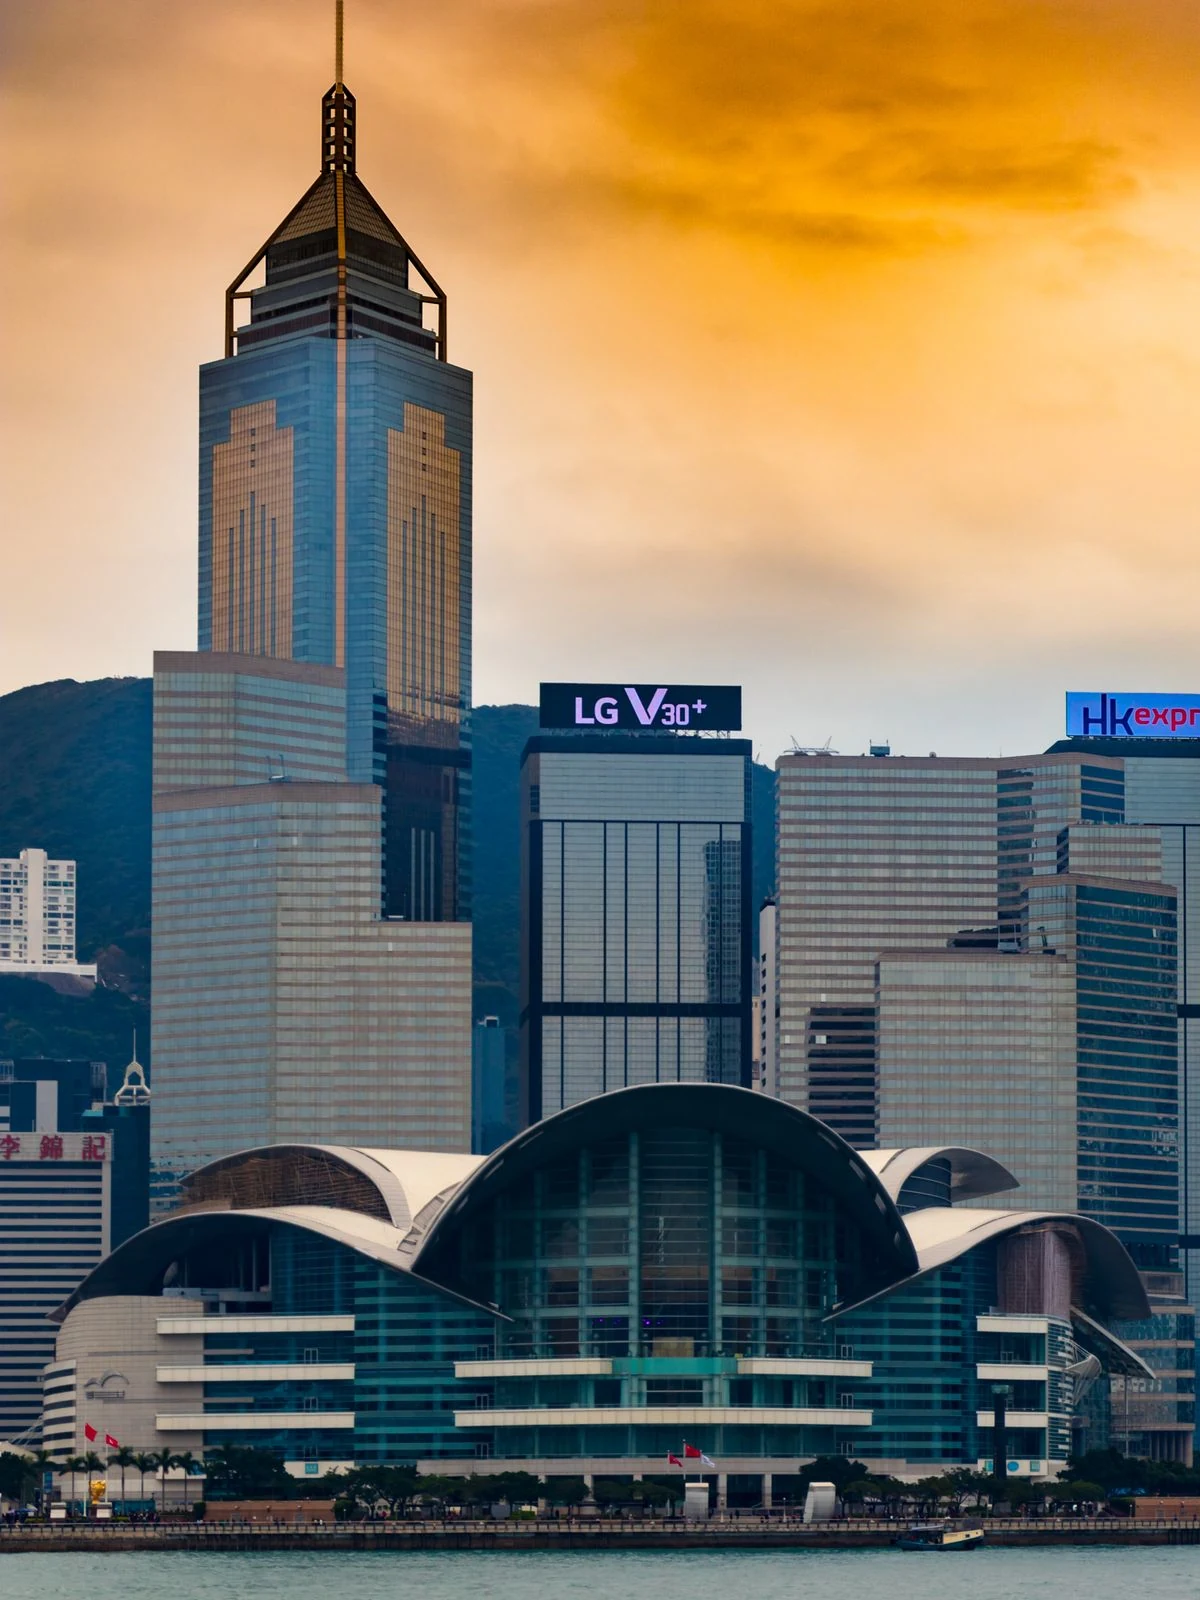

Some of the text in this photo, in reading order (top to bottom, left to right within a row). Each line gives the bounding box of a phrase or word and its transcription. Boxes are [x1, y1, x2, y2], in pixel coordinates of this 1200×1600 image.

[575, 688, 707, 725] LG V30+
[0, 1135, 106, 1160] 李錦記
